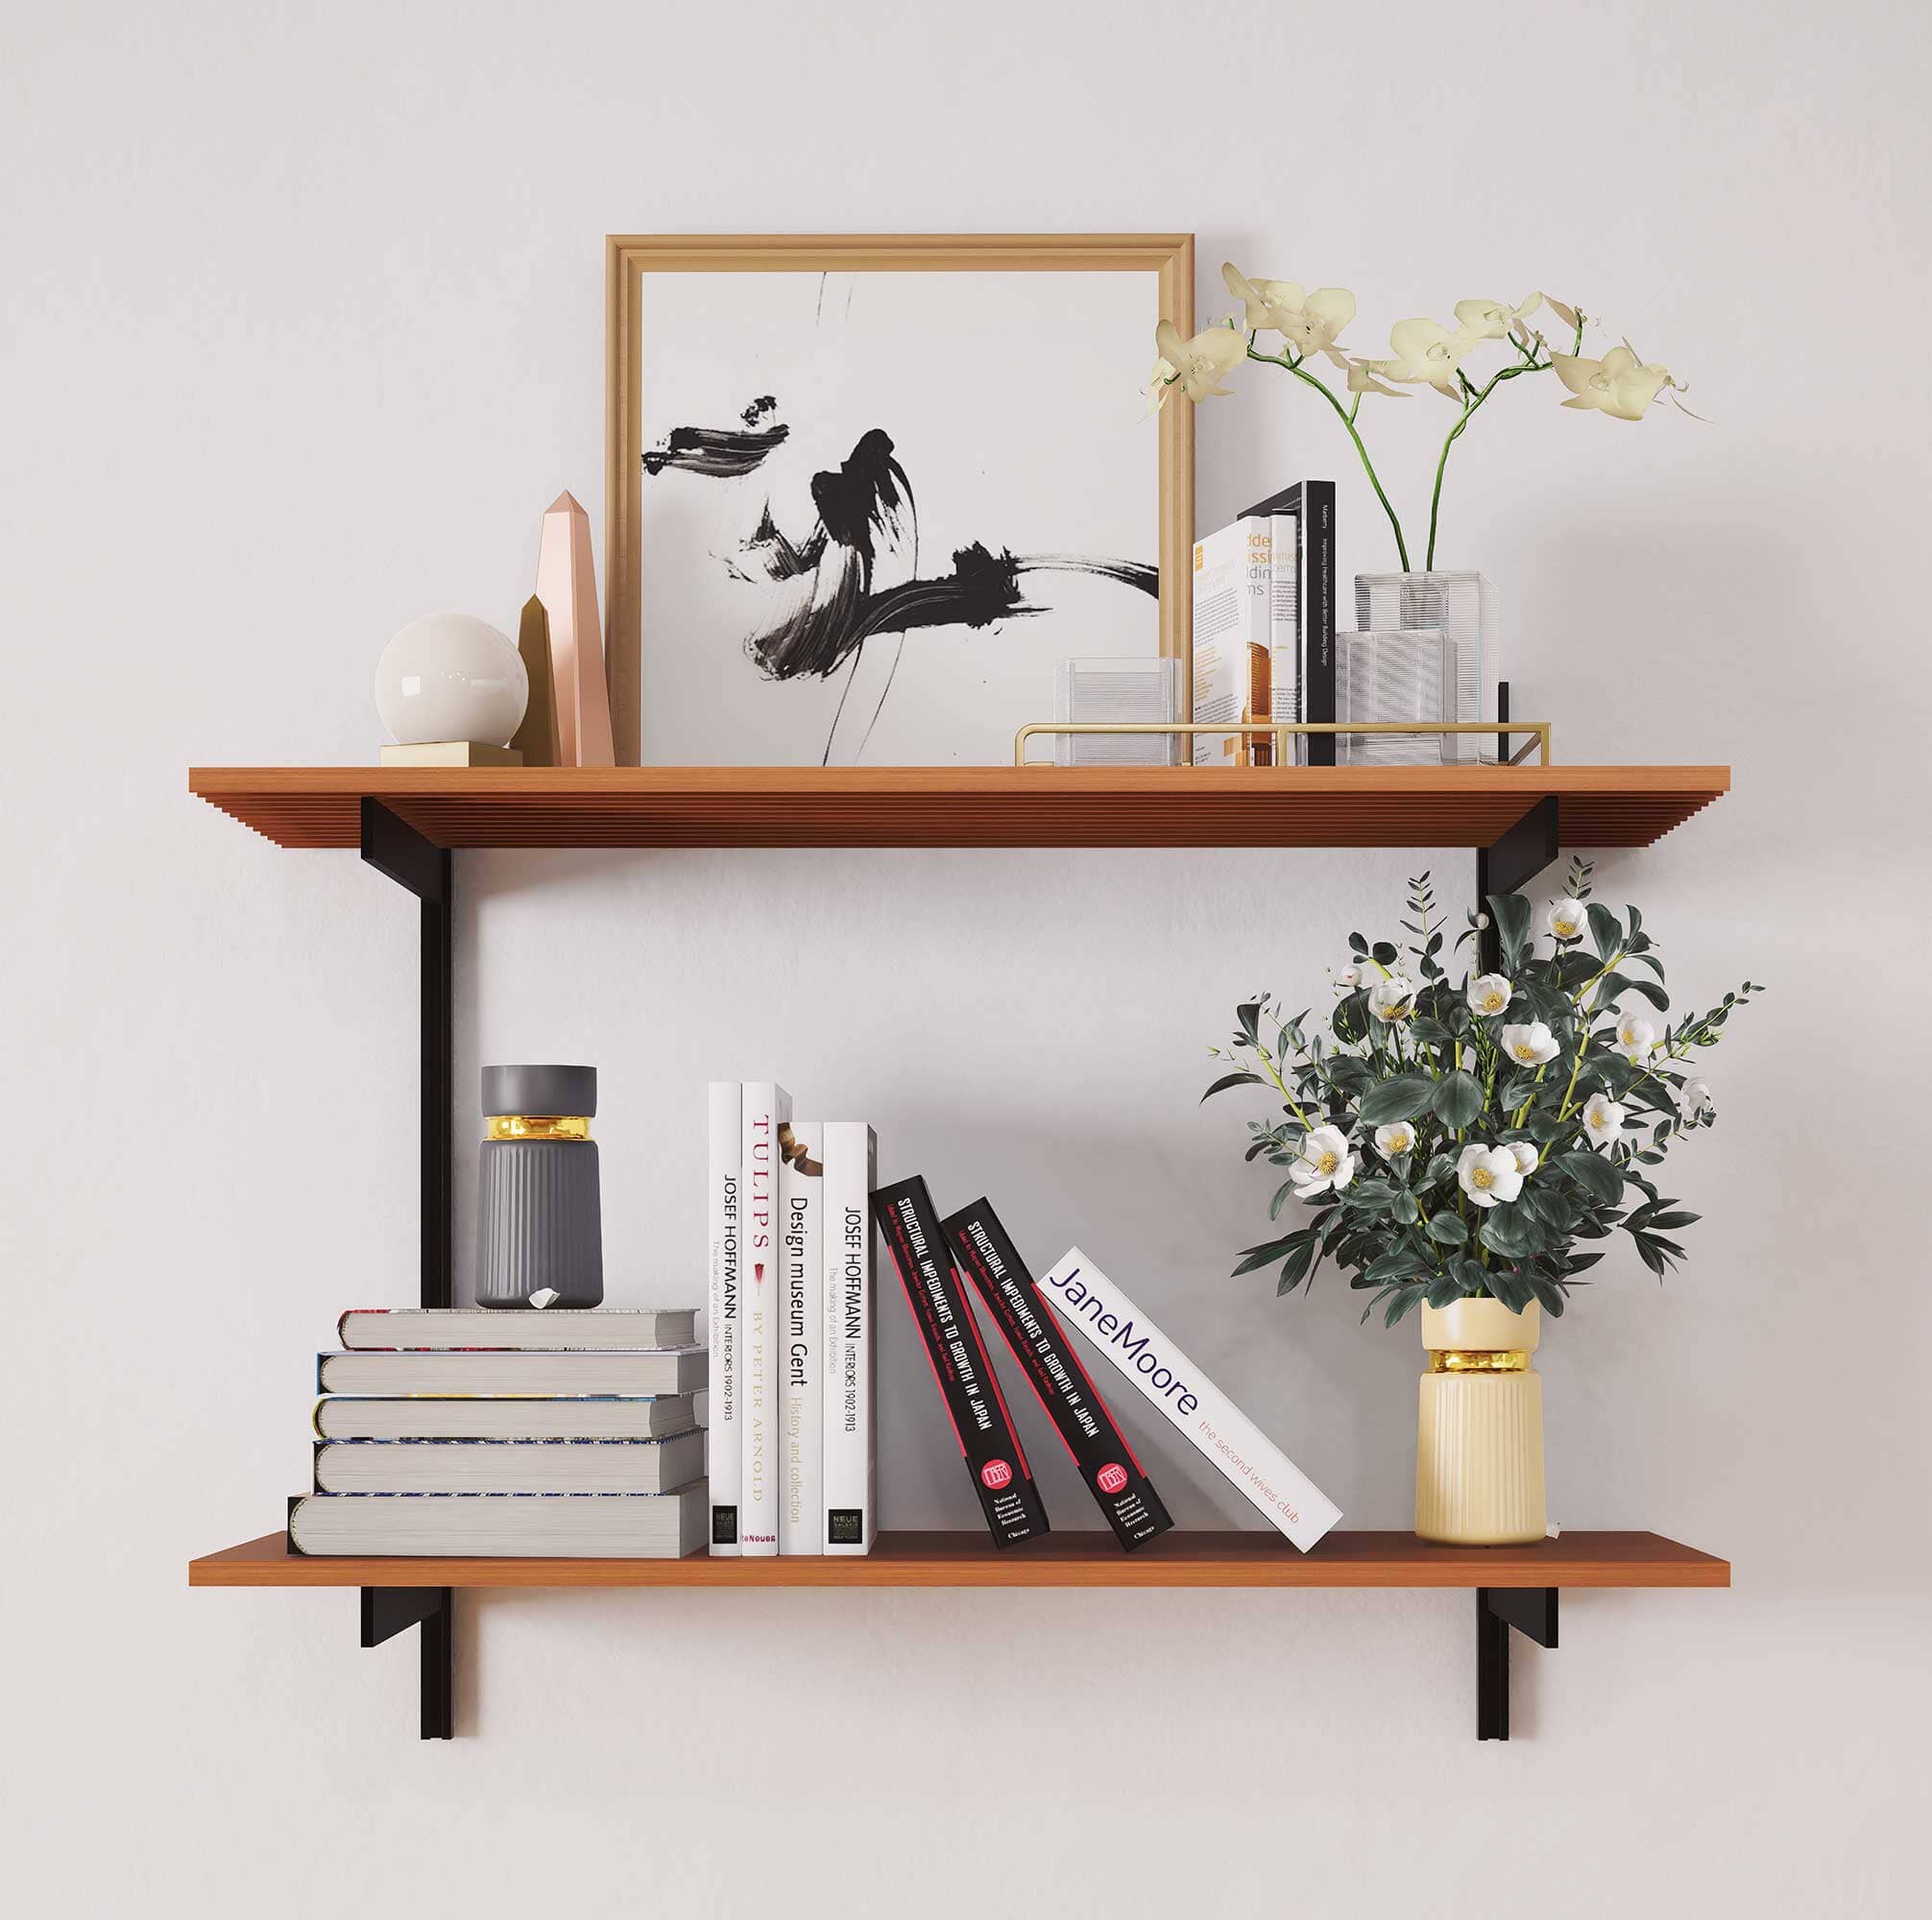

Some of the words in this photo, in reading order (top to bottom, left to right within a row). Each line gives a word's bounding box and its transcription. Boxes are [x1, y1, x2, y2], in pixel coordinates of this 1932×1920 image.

[724, 1174, 737, 1220] JOSEF
[753, 1114, 769, 1247] TULIPS
[785, 1198, 808, 1257] Design
[845, 1207, 861, 1249] JOSEF
[898, 1197, 929, 1259] STRUCTURAL
[724, 1226, 737, 1318] HOFFMANN
[920, 1259, 953, 1323] IMPEDIMENTS
[790, 1263, 804, 1336] museum
[845, 1254, 861, 1338] HOFFMANN
[754, 1312, 762, 1334] BY
[944, 1324, 959, 1339] TO
[967, 1220, 1006, 1280] STRUCTURAL
[1001, 1277, 1042, 1339] IMPEDIMENTS
[1035, 1337, 1051, 1354] TO
[1044, 1353, 1074, 1393] GROWTH
[1066, 1391, 1082, 1406] IN
[1074, 1407, 1099, 1438] JAPAN
[1050, 1268, 1198, 1416] JaneMoore
[754, 1345, 762, 1406] PETER
[790, 1344, 808, 1386] Gent
[950, 1341, 975, 1382] GROWTH
[724, 1375, 733, 1421] 1902-1913
[845, 1390, 856, 1432] 1902-1913
[964, 1382, 980, 1396] IN
[787, 1398, 802, 1438] History
[970, 1400, 993, 1430] JAPAN
[754, 1419, 762, 1501] ARNOLD
[790, 1442, 802, 1463] and
[1198, 1421, 1217, 1441] the
[1215, 1439, 1254, 1476] second
[1249, 1473, 1278, 1503] wives
[1276, 1500, 1299, 1524] club
[790, 1467, 803, 1524] collection
[833, 1515, 858, 1524] NEUE
[1007, 1527, 1030, 1540] Chicago
